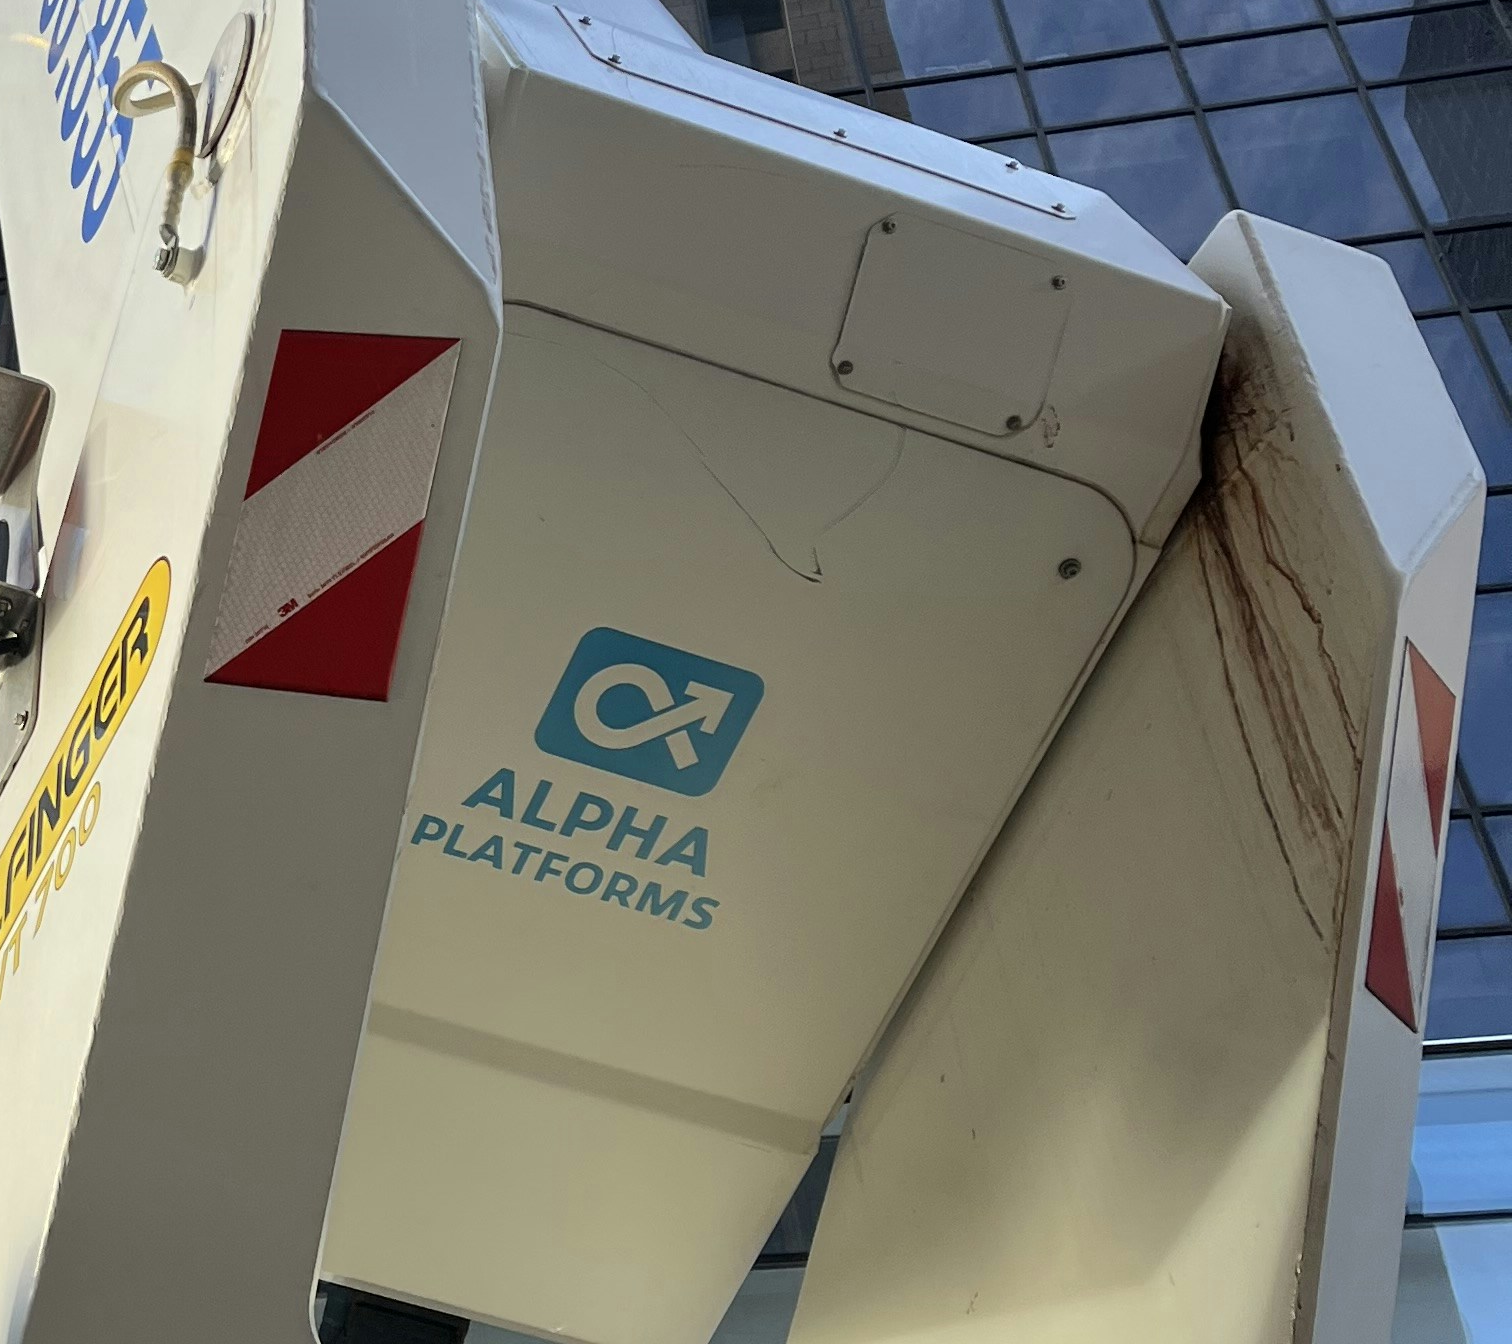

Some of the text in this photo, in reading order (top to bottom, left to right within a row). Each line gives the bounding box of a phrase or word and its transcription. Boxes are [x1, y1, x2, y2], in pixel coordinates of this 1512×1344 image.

[277, 598, 299, 618] 3M
[33, 781, 101, 939] 700
[410, 814, 720, 931] PLATFORMS
[462, 768, 710, 877] ALPHA
